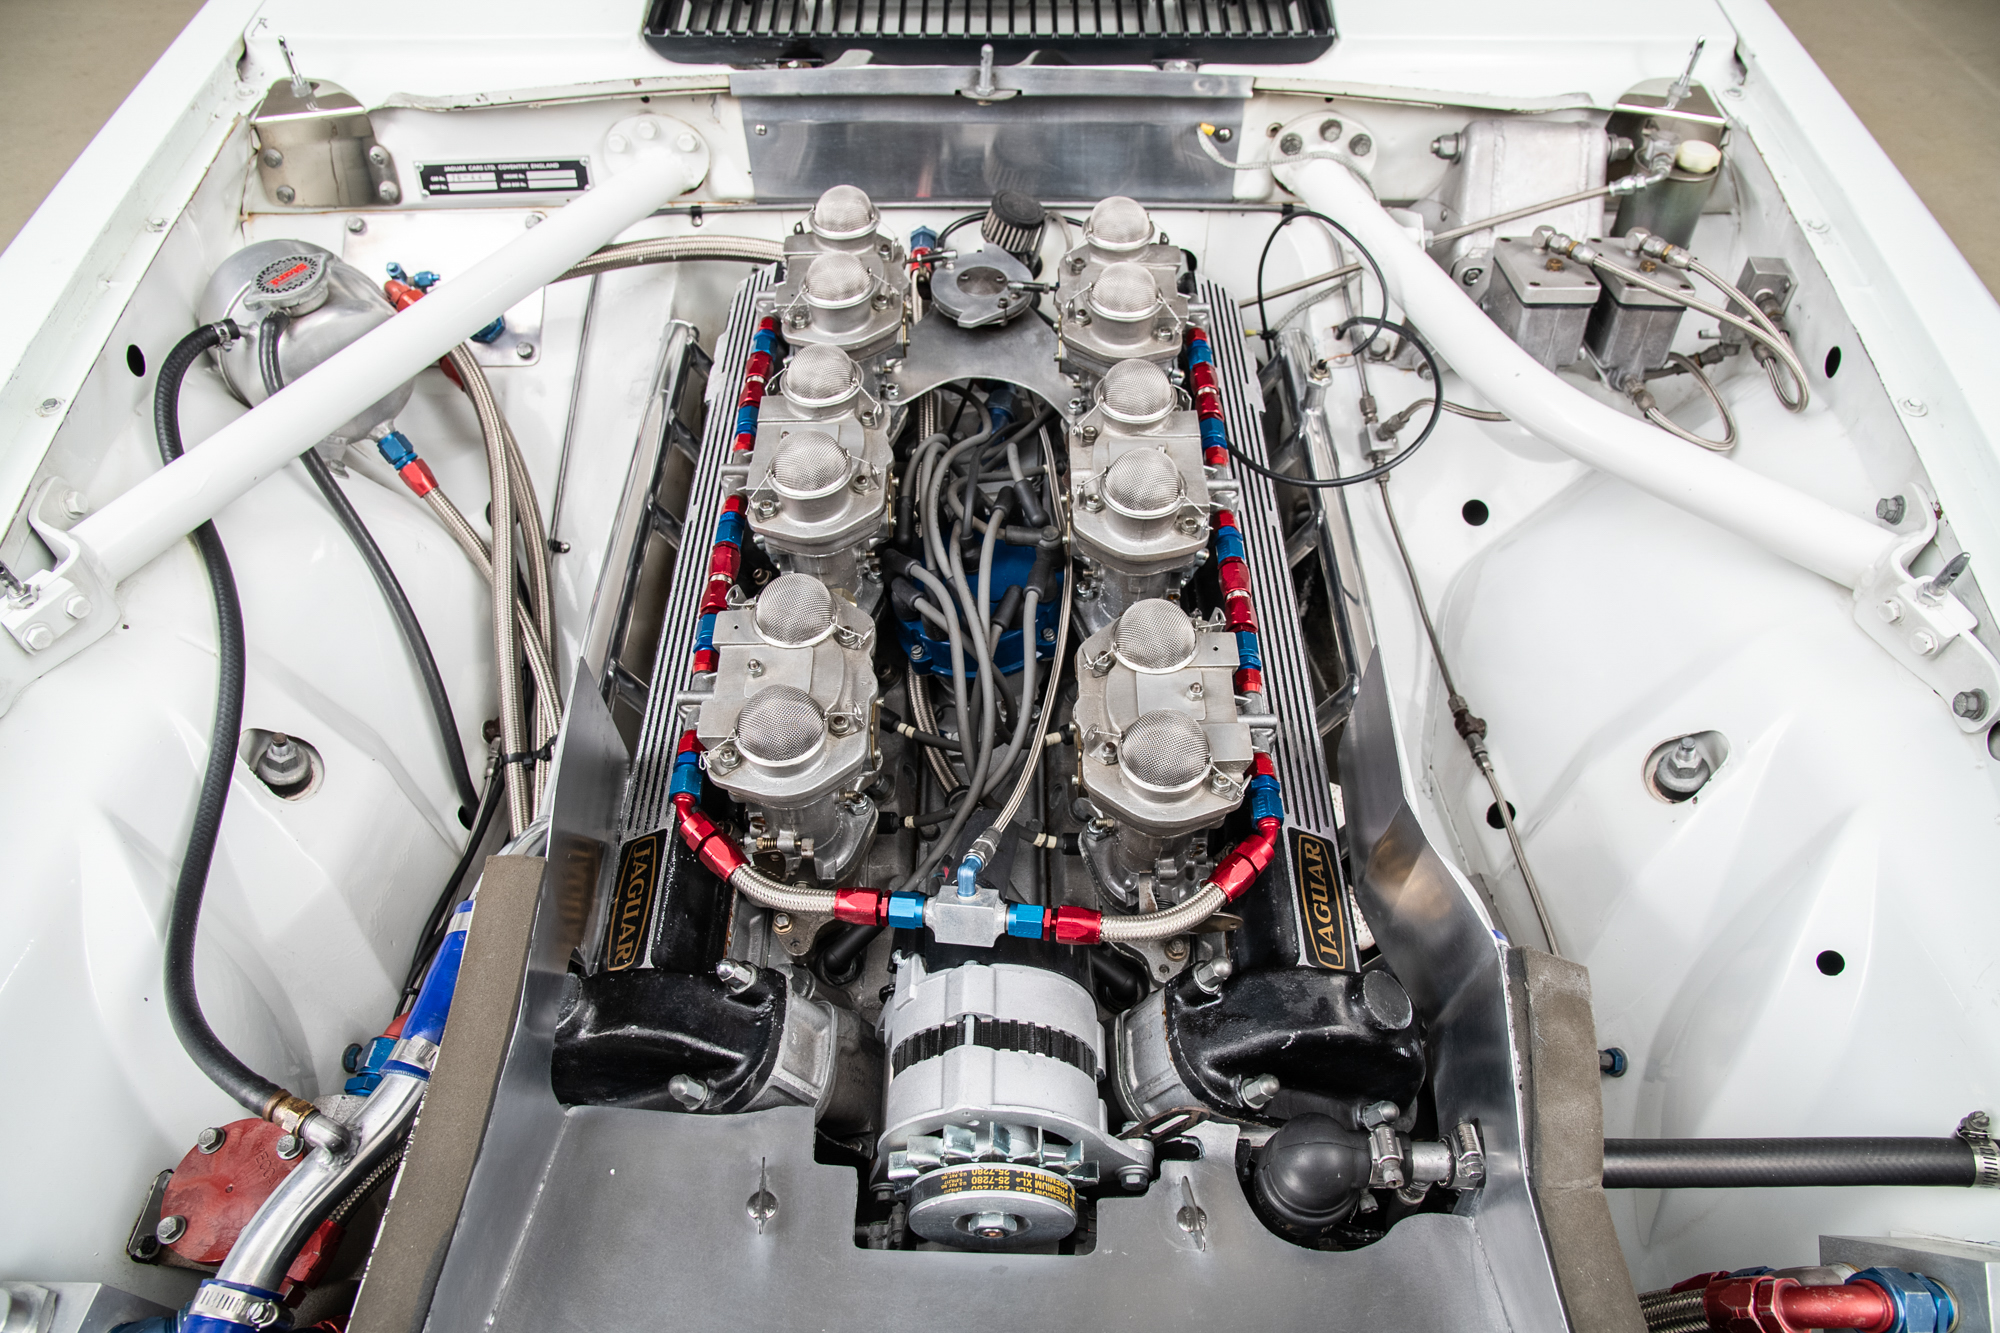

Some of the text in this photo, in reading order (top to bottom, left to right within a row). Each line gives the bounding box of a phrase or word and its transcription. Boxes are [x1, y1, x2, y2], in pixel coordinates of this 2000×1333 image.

[614, 846, 651, 965] JAGUAR
[1304, 844, 1340, 964] JAGUAR
[971, 1176, 1010, 1185] 25-7280
[1034, 1180, 1068, 1199] PREMIUM
